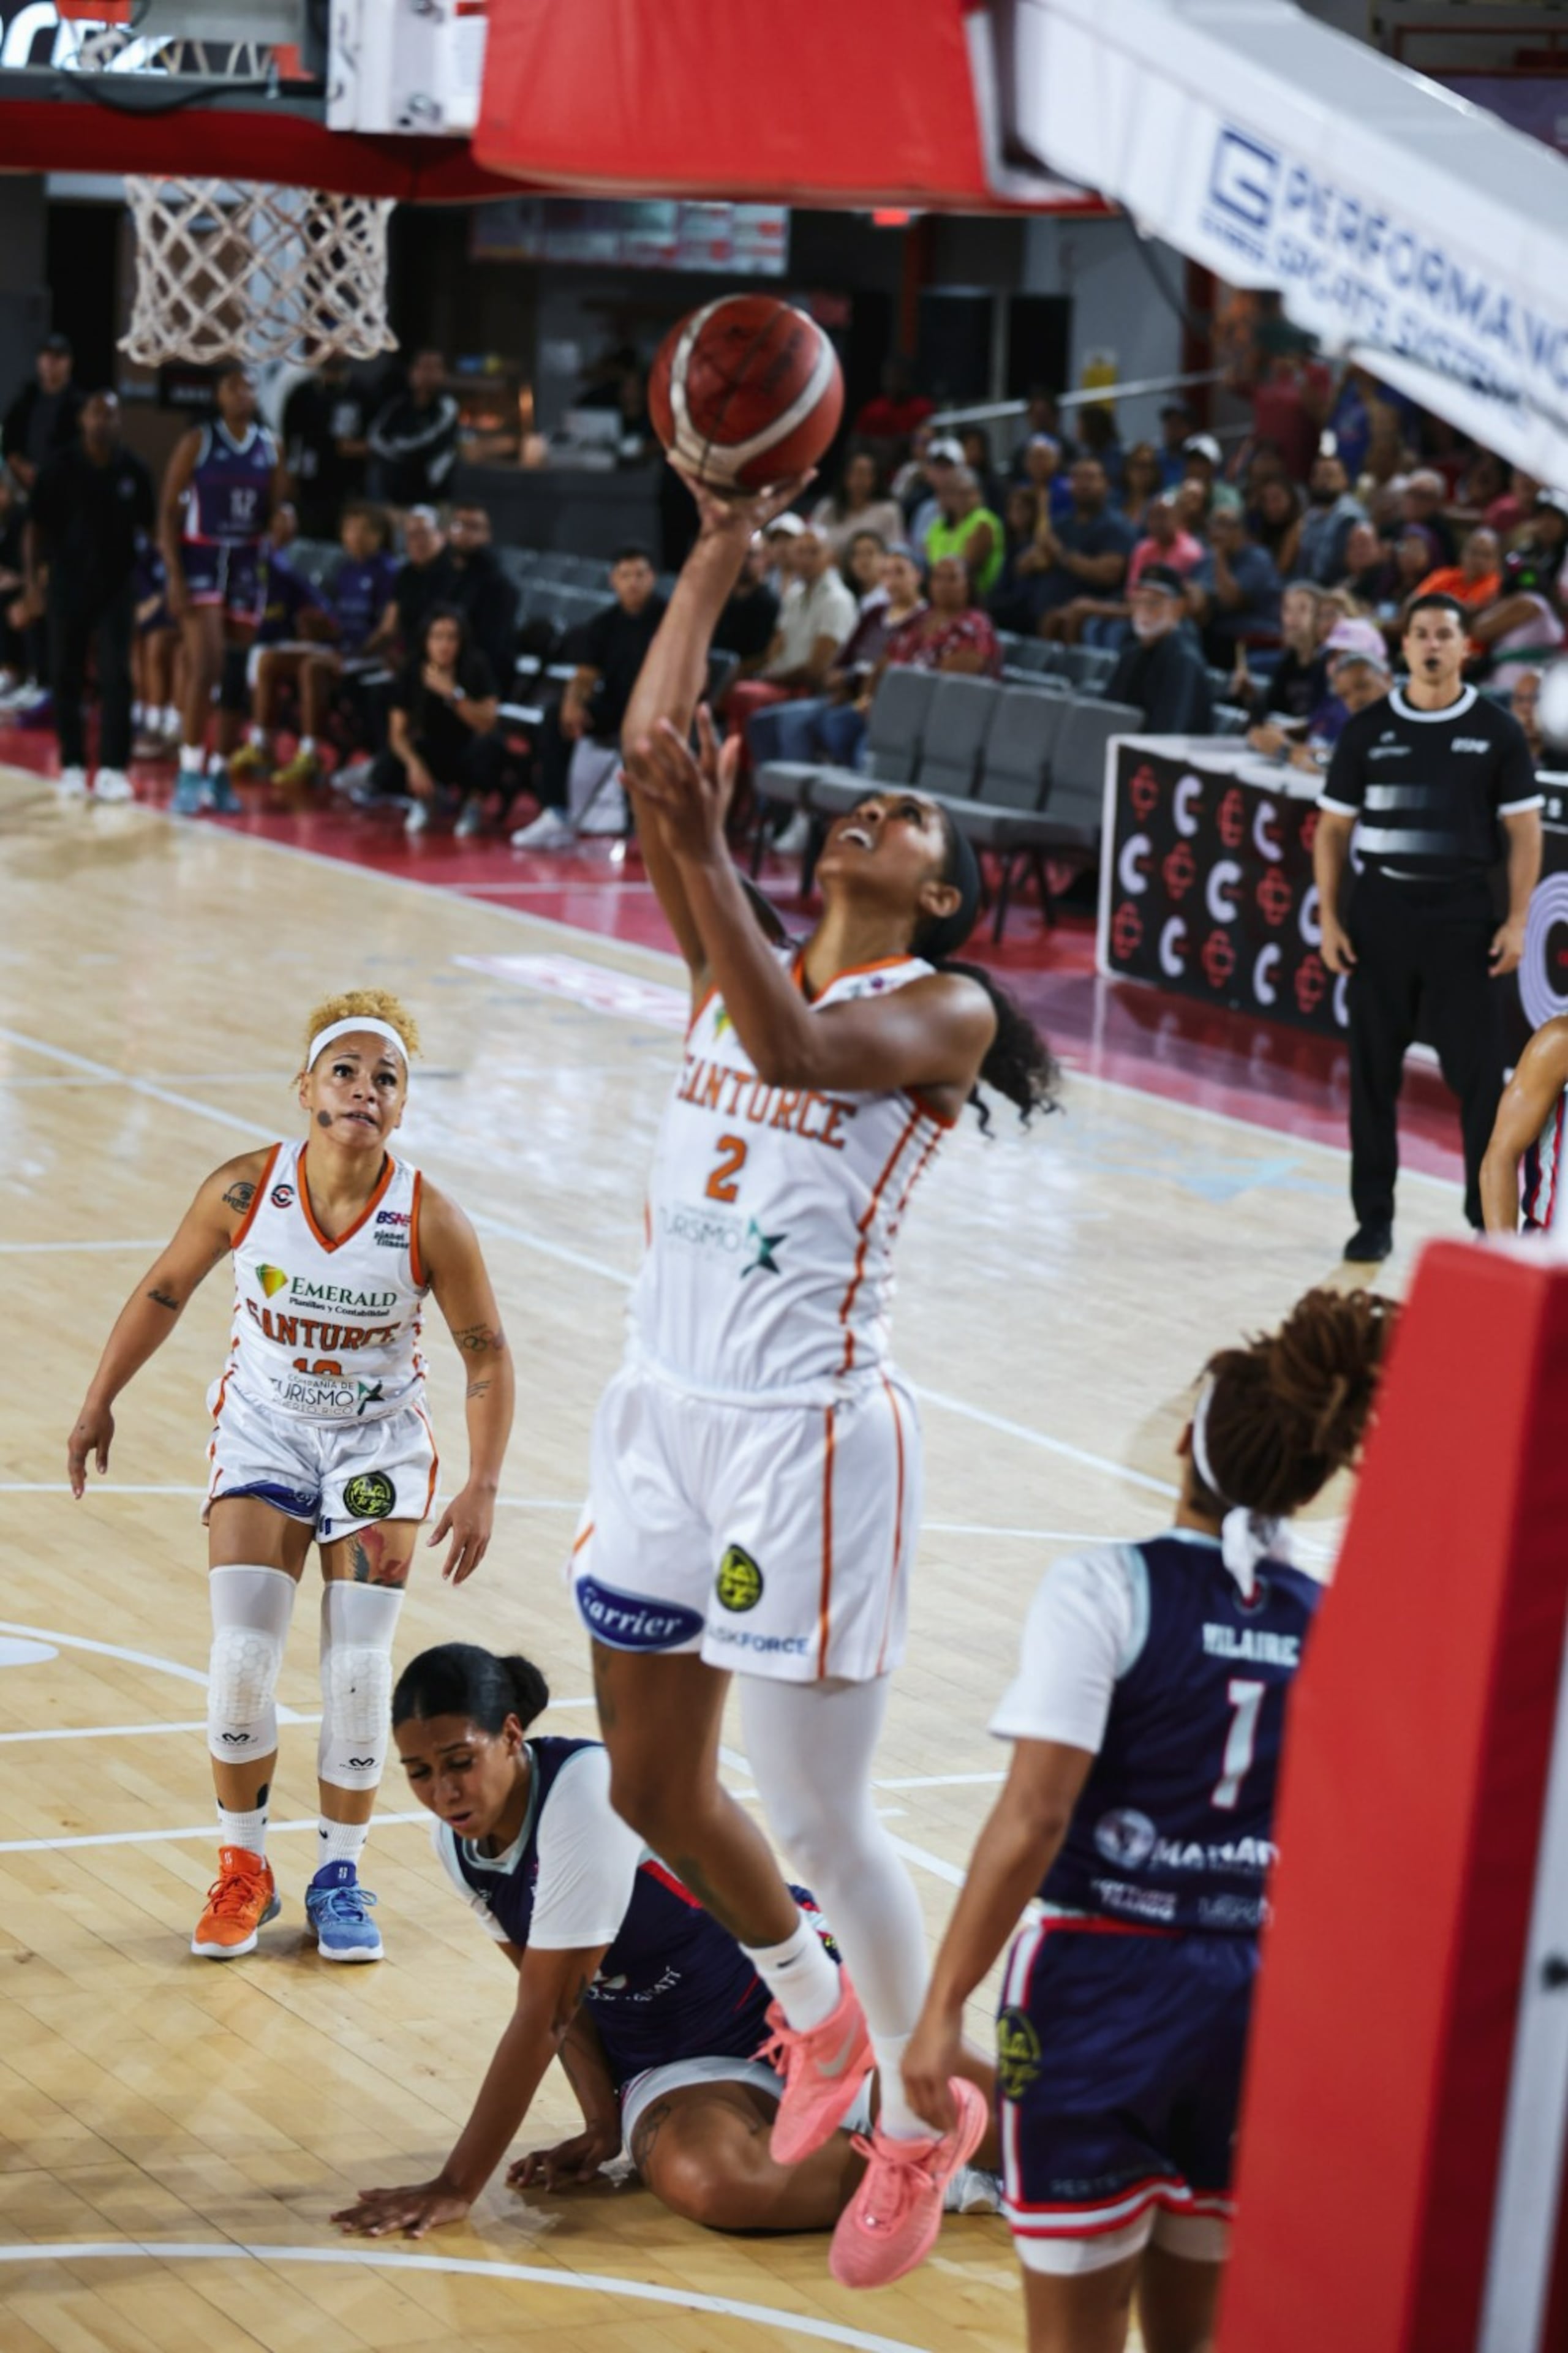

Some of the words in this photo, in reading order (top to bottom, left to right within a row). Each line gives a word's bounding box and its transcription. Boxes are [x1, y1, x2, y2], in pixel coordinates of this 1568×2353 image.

[705, 1134, 748, 1204] 2
[290, 1276, 397, 1308] EMERALD
[584, 1586, 682, 1636] Carrier
[1210, 1678, 1265, 1809] 1
